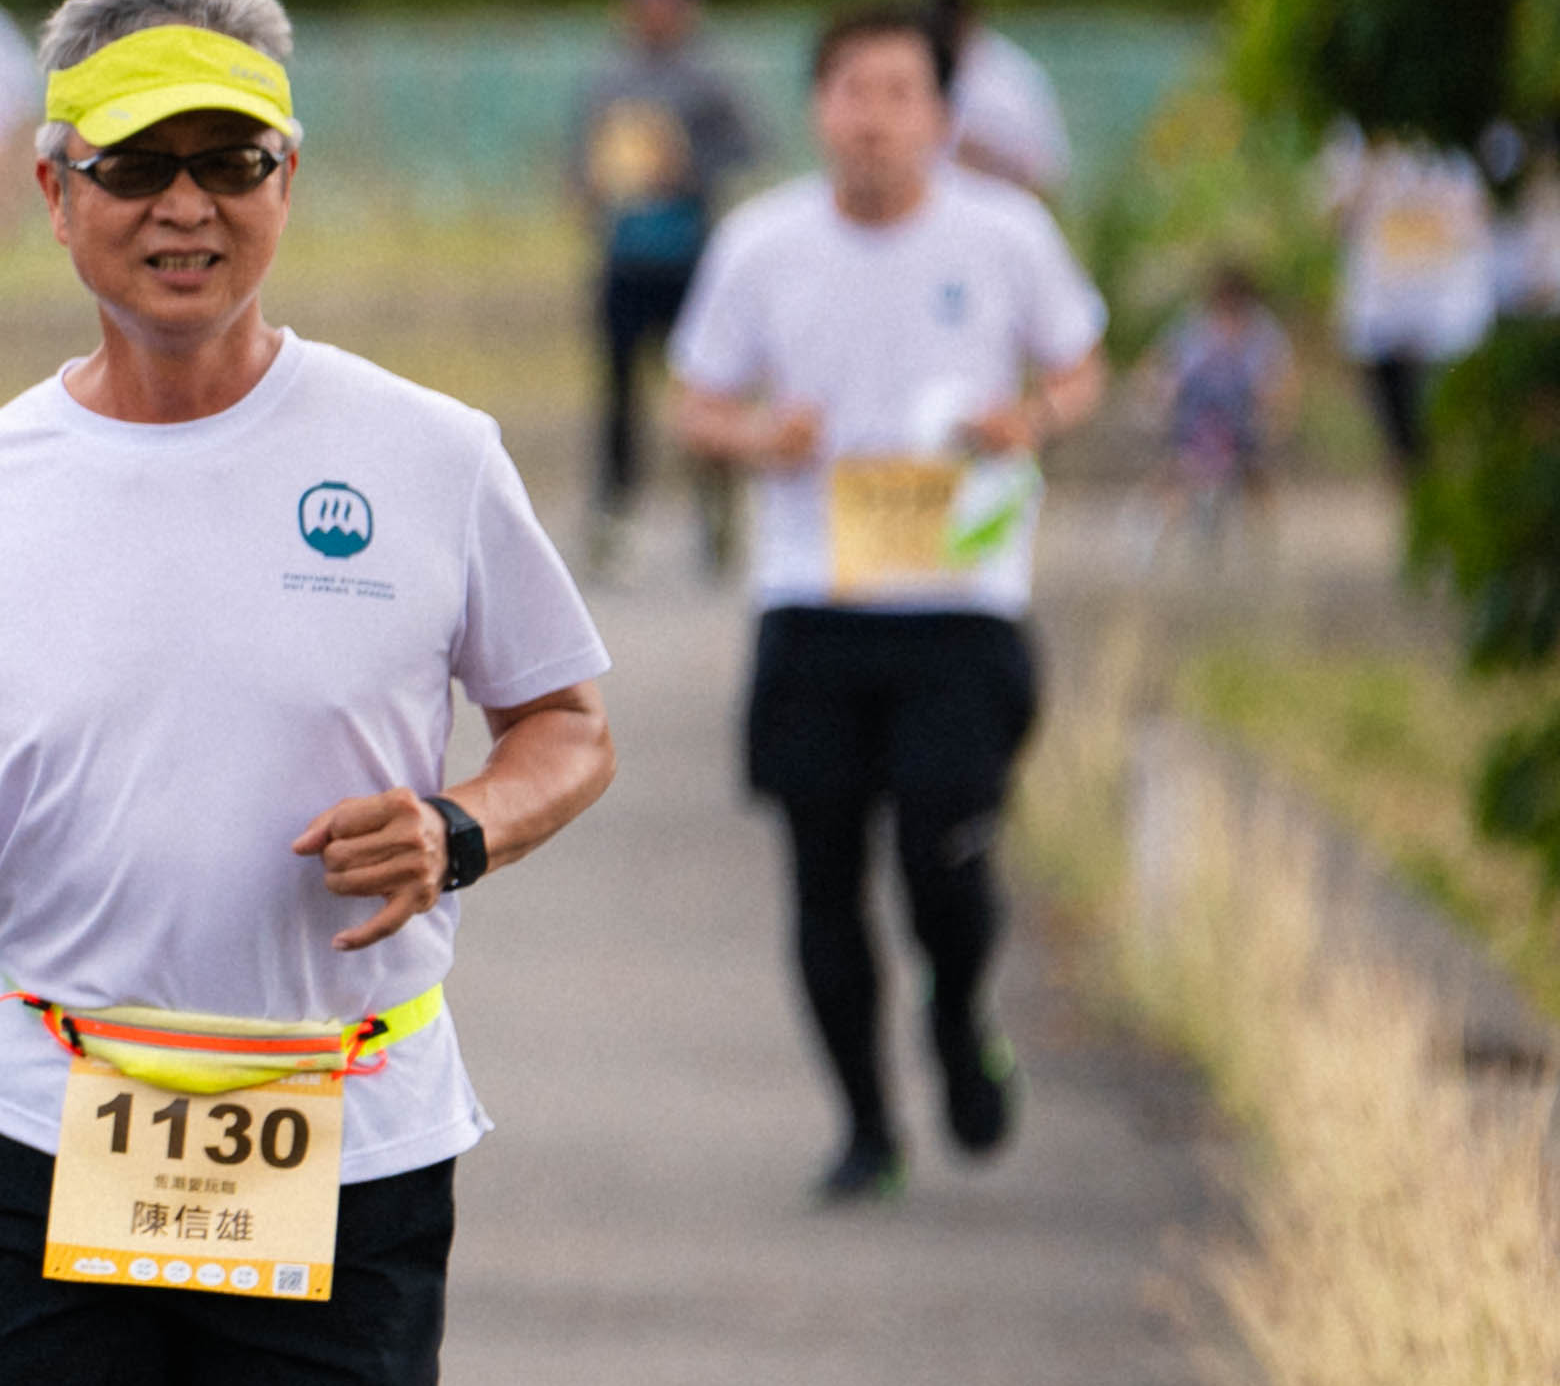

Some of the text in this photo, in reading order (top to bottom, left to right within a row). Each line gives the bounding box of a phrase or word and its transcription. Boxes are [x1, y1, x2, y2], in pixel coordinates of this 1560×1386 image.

[96, 1092, 310, 1169] 1130
[130, 1199, 255, 1243] 陳信雄
